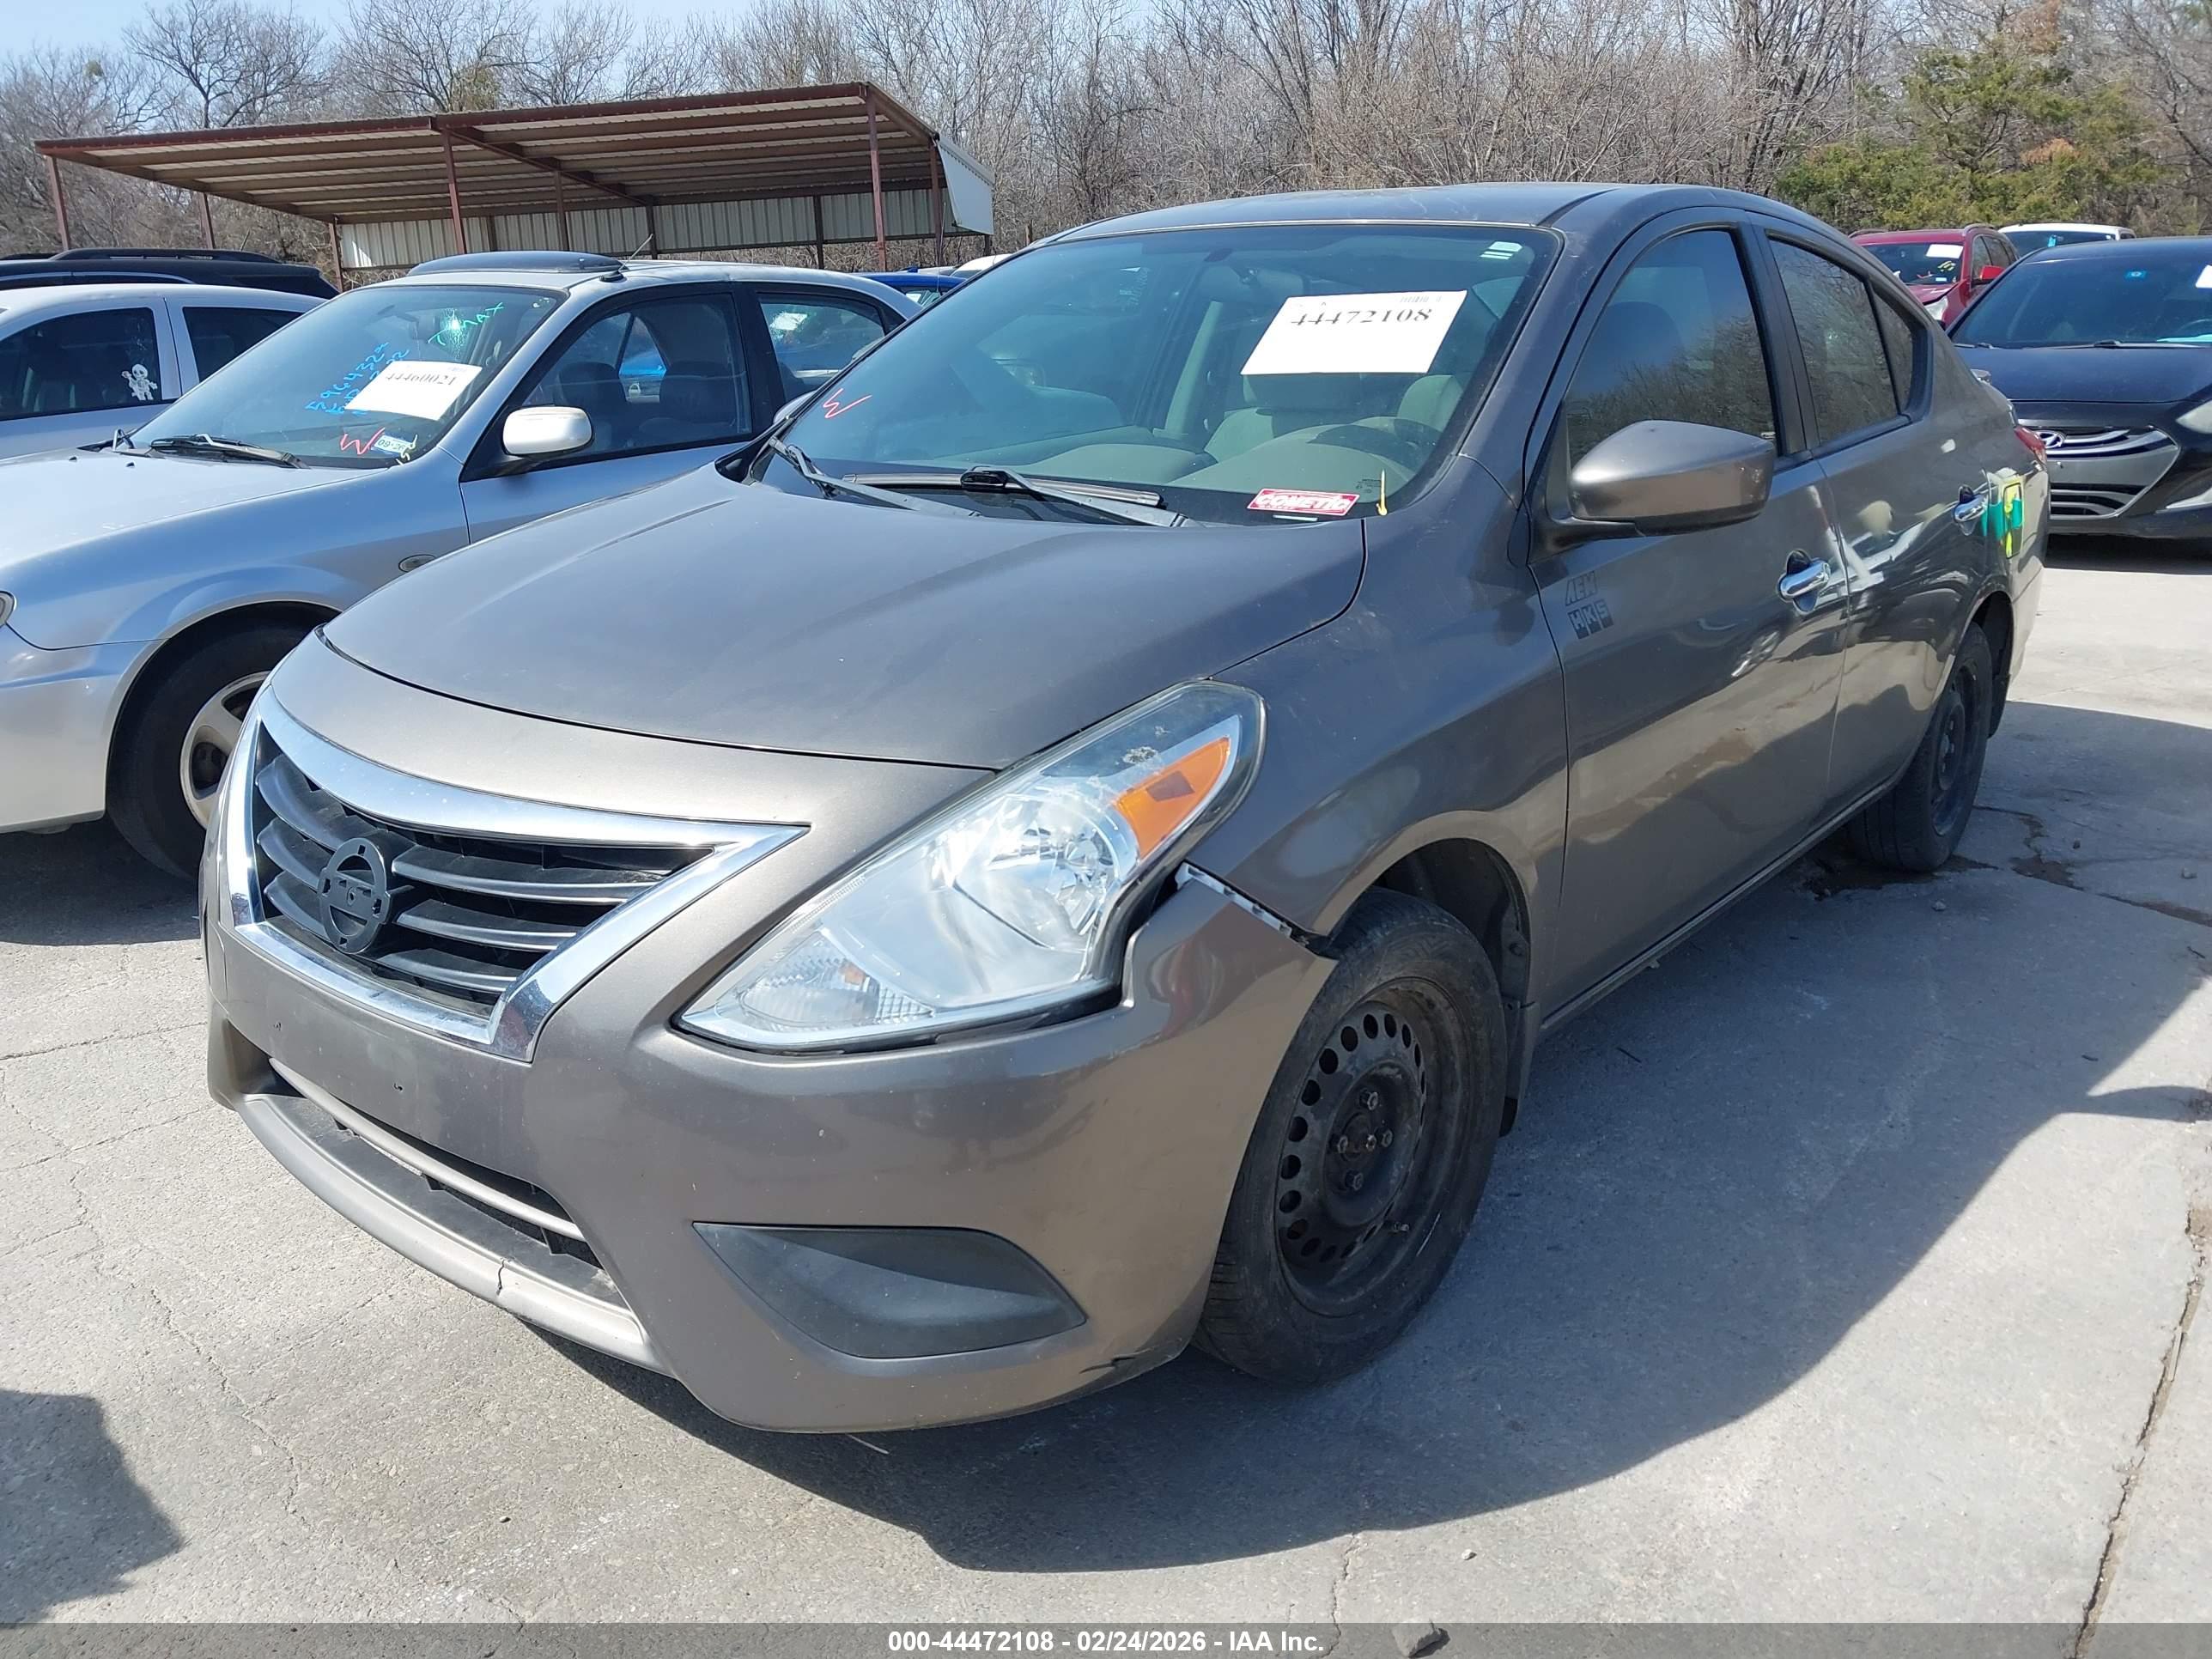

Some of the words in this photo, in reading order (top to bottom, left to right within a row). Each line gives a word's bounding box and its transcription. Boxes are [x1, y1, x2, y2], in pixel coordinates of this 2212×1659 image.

[1291, 308, 1431, 325] 44472108
[386, 373, 457, 386] 44460021
[1567, 599, 1614, 639] HKS
